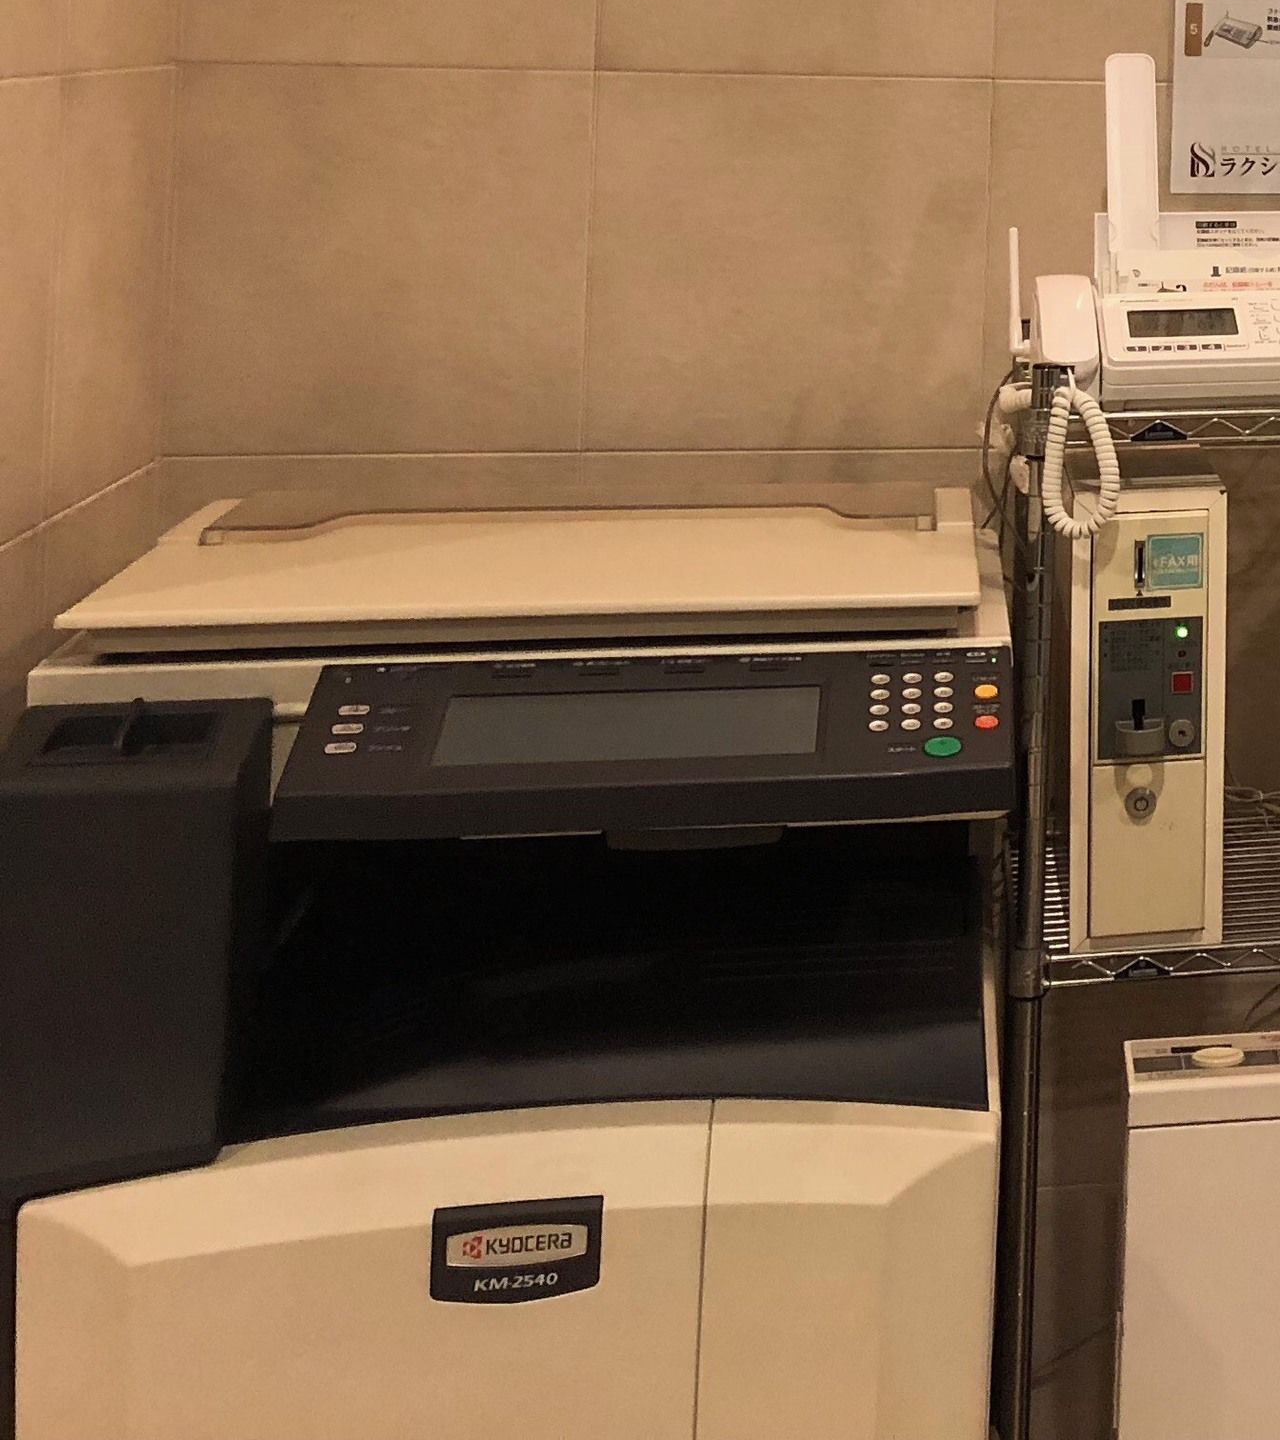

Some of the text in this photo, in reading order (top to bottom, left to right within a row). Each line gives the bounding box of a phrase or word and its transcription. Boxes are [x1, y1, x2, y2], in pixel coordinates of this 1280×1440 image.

[1190, 24, 1198, 35] 5
[486, 1232, 572, 1256] KYOCERA
[473, 1272, 558, 1292] KM-2540
